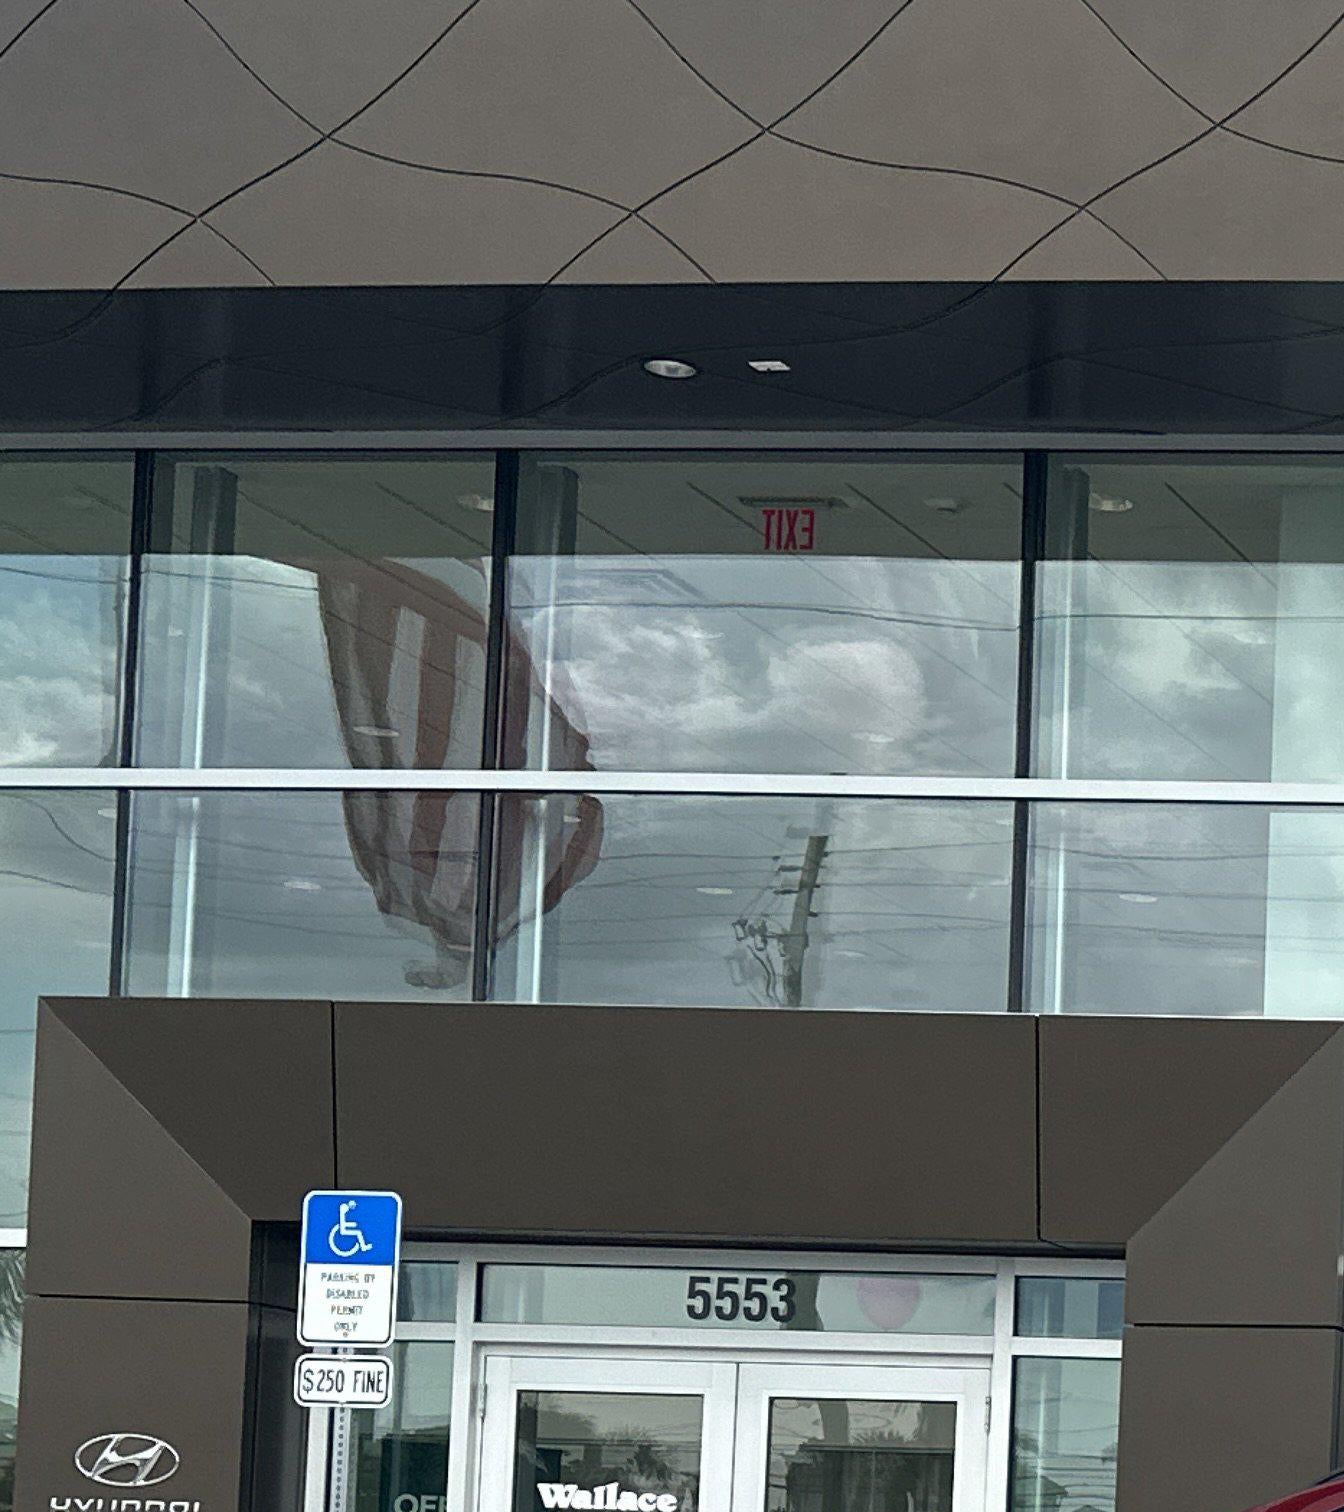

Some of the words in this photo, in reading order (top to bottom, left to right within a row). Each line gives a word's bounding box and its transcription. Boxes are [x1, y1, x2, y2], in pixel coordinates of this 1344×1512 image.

[686, 1276, 796, 1323] 5553
[302, 1368, 345, 1394] $250
[353, 1370, 384, 1394] FINE
[537, 1481, 678, 1512] Wallace
